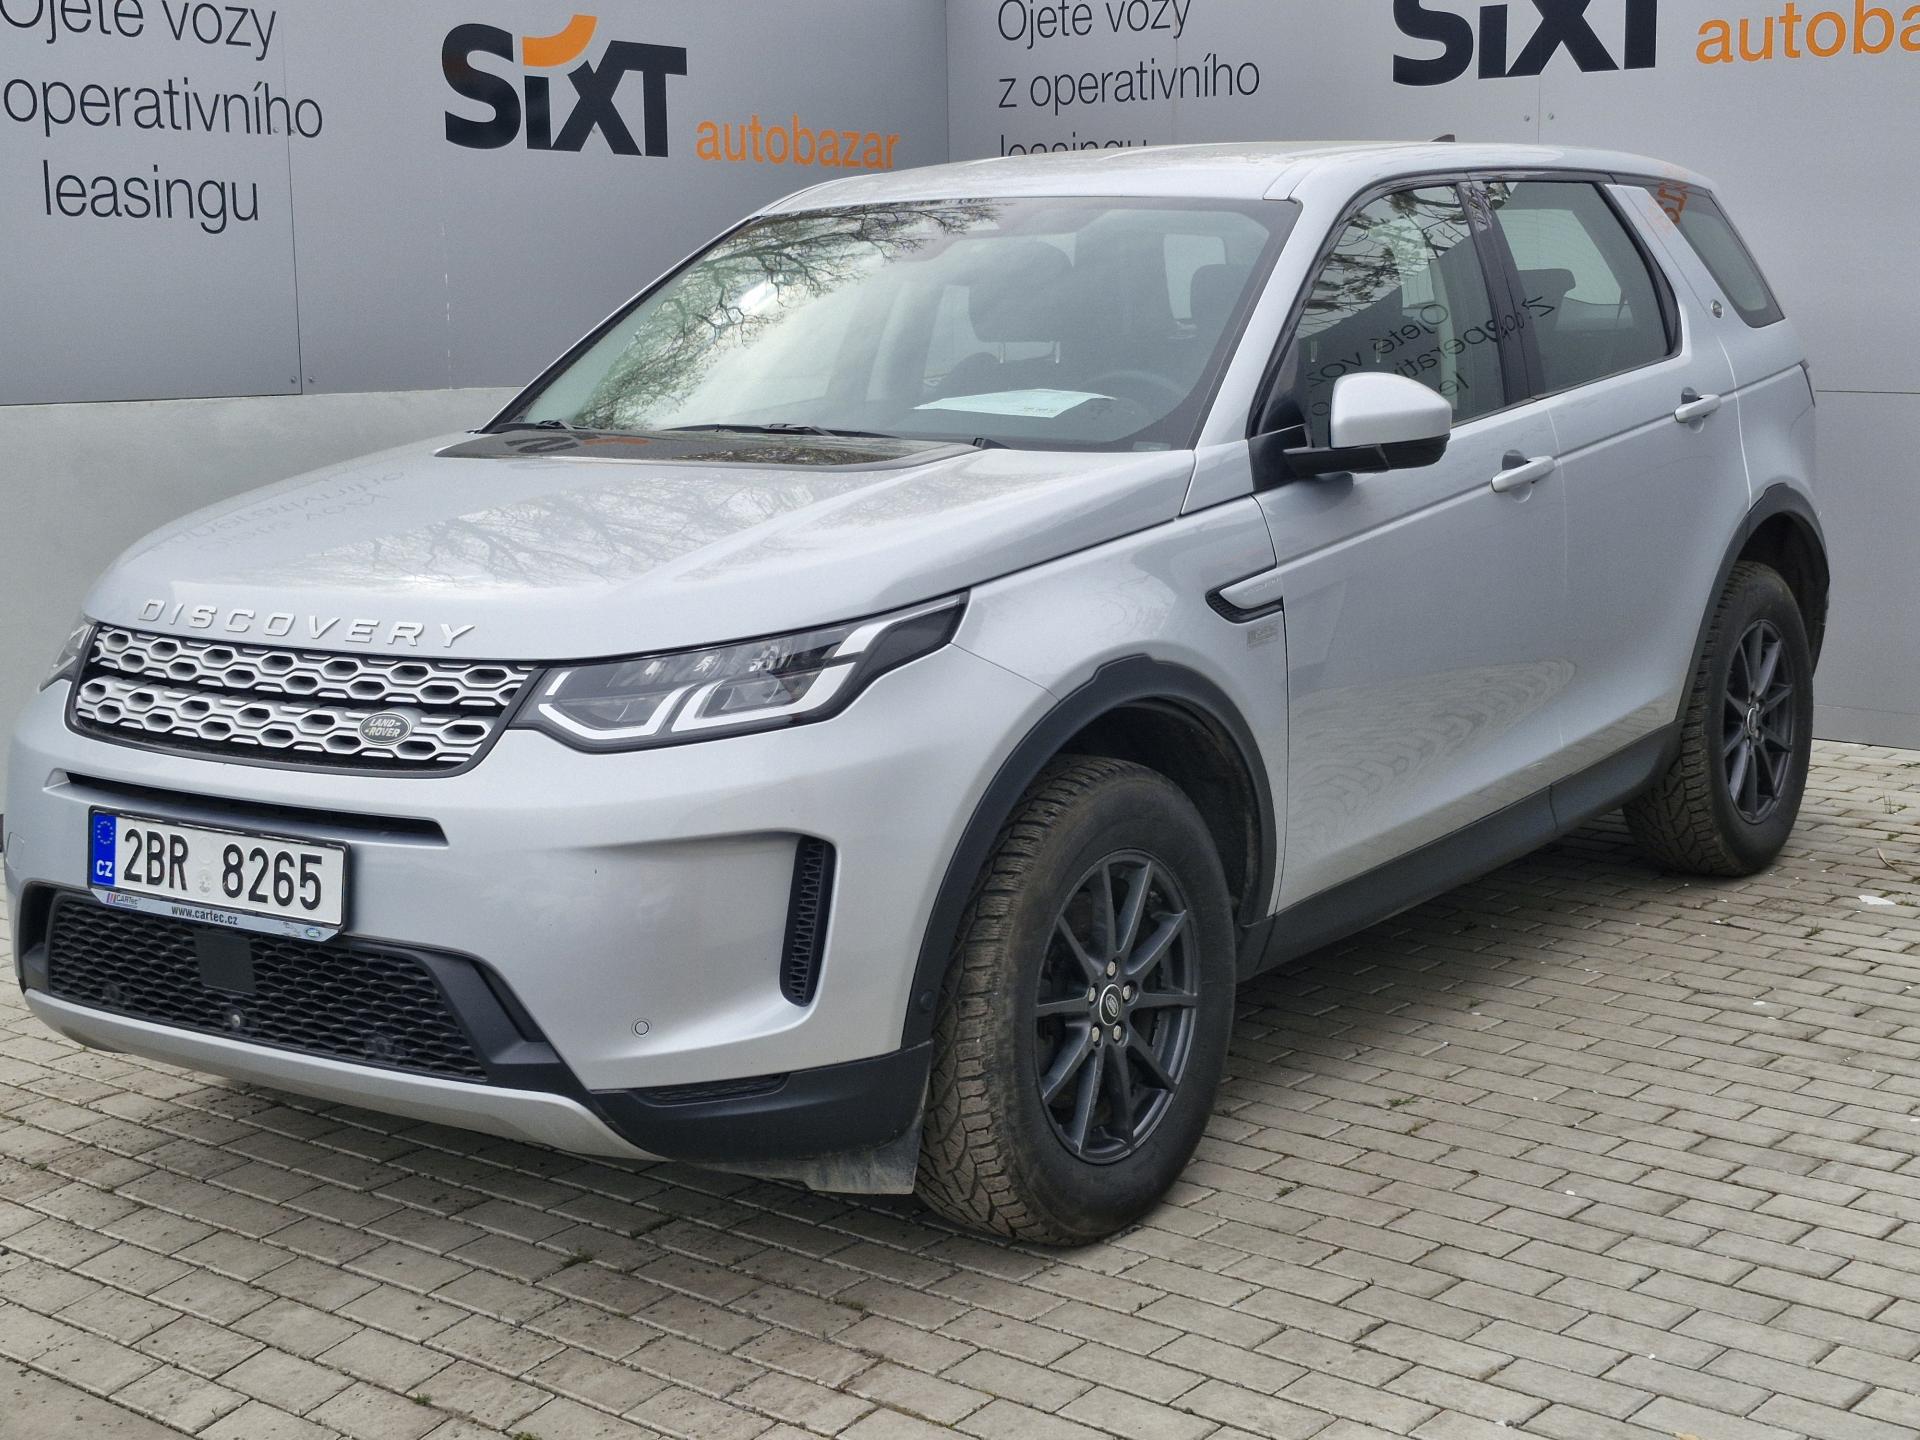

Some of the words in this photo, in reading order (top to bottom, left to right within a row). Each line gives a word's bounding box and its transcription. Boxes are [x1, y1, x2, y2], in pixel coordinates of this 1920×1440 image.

[162, 0, 276, 61] vozy
[1106, 0, 1191, 39] vozy
[3, 77, 323, 138] operativního
[999, 77, 1017, 108] z
[1030, 53, 1260, 115] operativního
[696, 114, 899, 169] autobazar
[43, 160, 258, 234] leasingu
[137, 599, 475, 647] DISCOVERY
[96, 860, 113, 877] CZ
[124, 828, 189, 891] 2BR
[222, 843, 323, 911] 8265
[171, 905, 238, 926] www.cartec.cz
